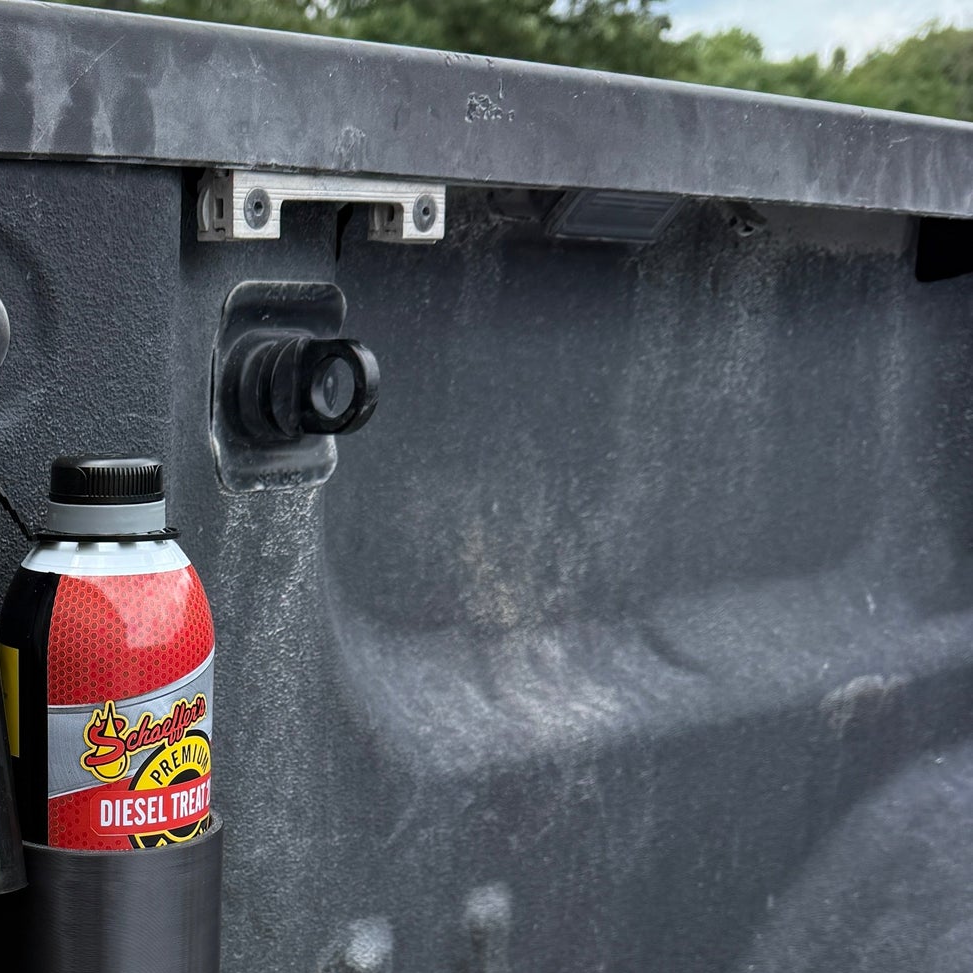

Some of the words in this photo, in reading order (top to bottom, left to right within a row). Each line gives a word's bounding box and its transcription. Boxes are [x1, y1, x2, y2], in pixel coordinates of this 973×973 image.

[85, 696, 206, 767] Schaeffer's
[150, 743, 209, 785] PREMIUM
[100, 796, 167, 826] DIESEL
[171, 783, 205, 819] TREAT
